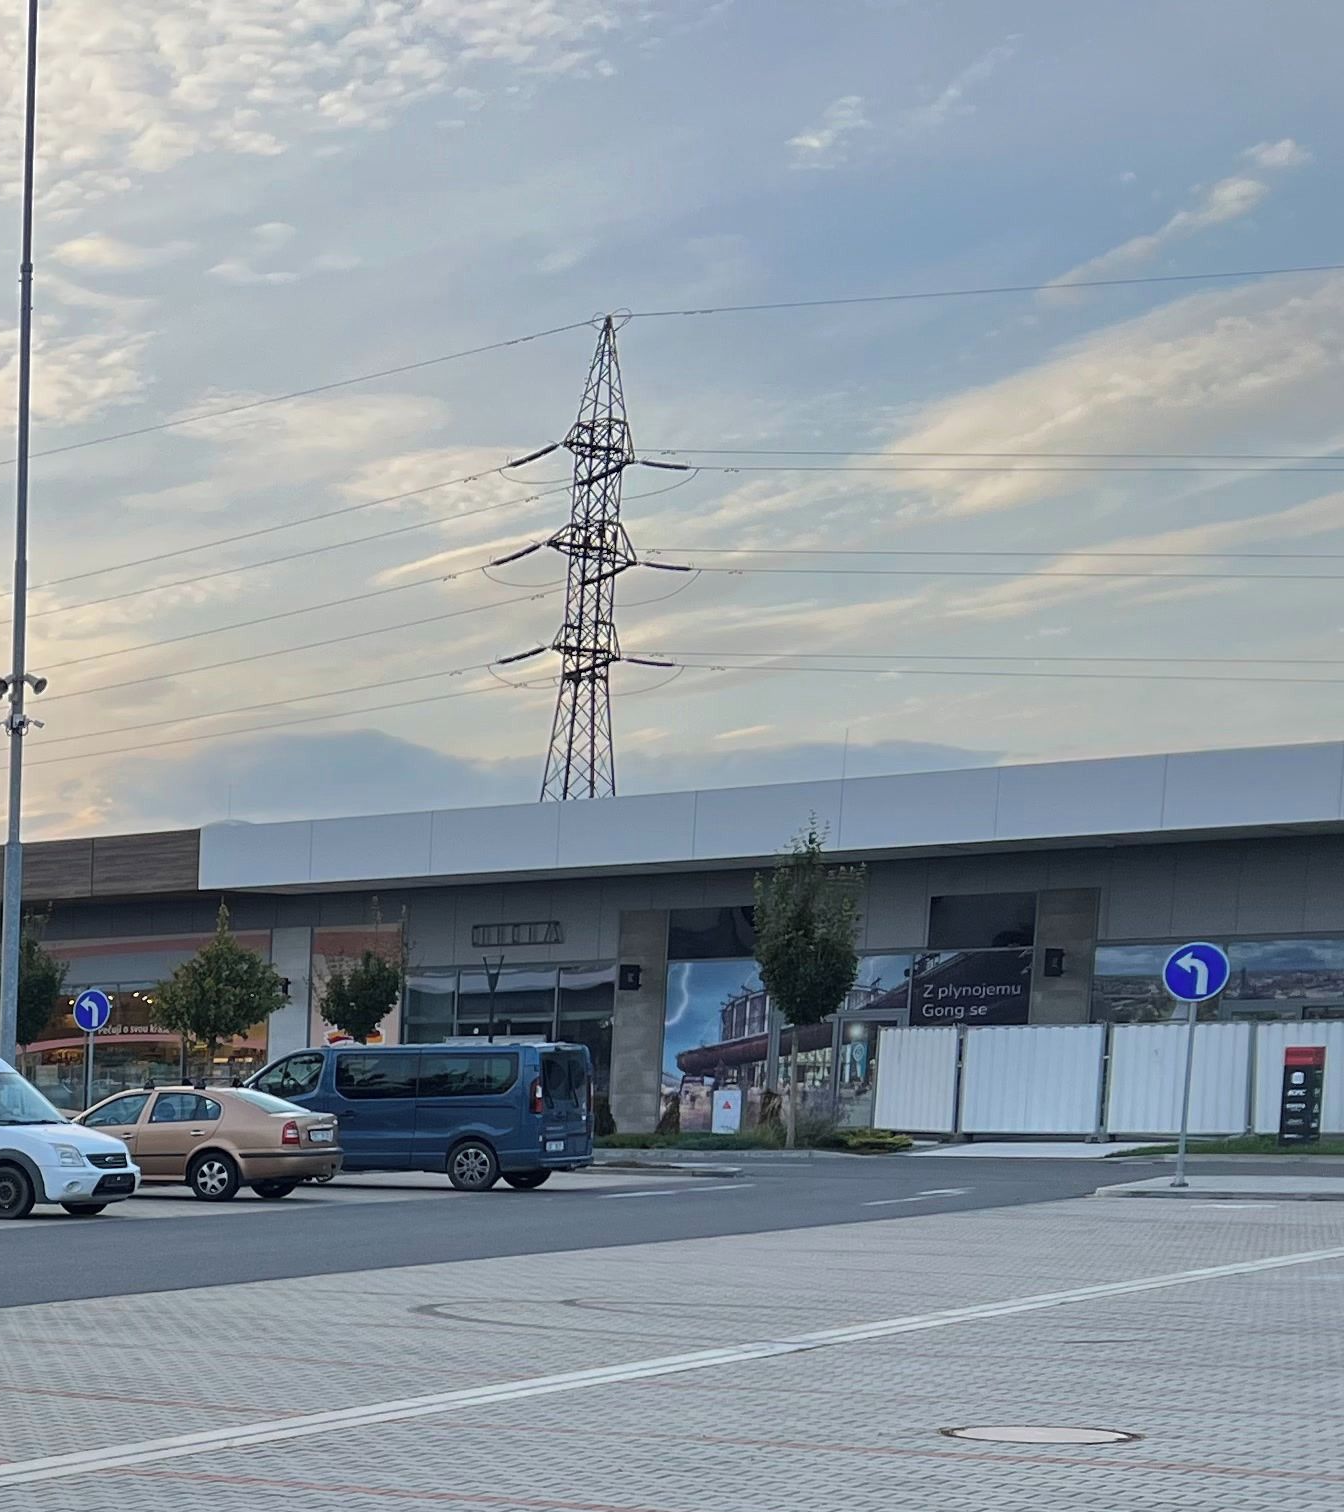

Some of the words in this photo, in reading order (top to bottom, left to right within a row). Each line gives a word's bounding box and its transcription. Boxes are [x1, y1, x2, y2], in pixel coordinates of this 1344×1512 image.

[923, 984, 934, 998] Z
[938, 982, 1022, 1000] plynojemu
[922, 1003, 965, 1019] Gong
[970, 1005, 988, 1016] se
